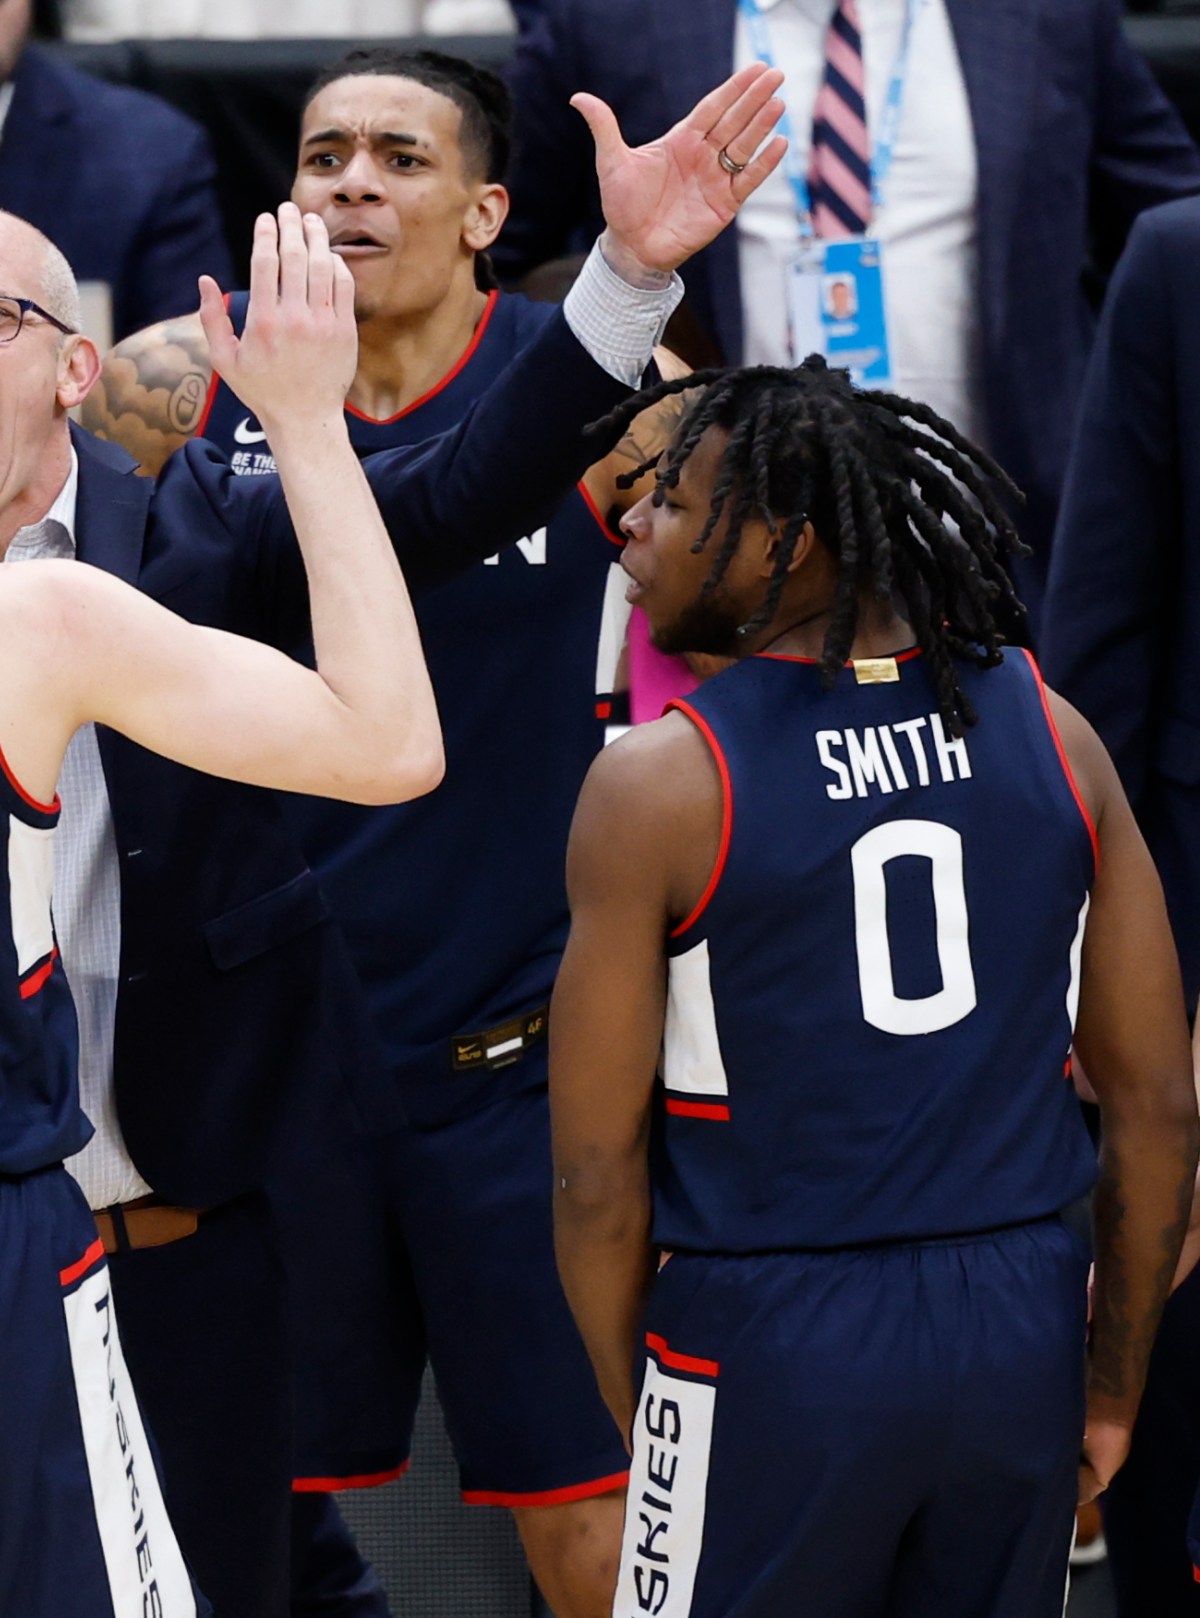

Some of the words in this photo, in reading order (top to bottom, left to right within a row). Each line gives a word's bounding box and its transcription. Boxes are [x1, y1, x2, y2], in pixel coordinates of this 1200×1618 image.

[231, 451, 251, 467] BE
[254, 454, 278, 469] THE
[815, 713, 972, 800] SMITH
[851, 819, 977, 1036] 0
[631, 1392, 682, 1618] SKIES
